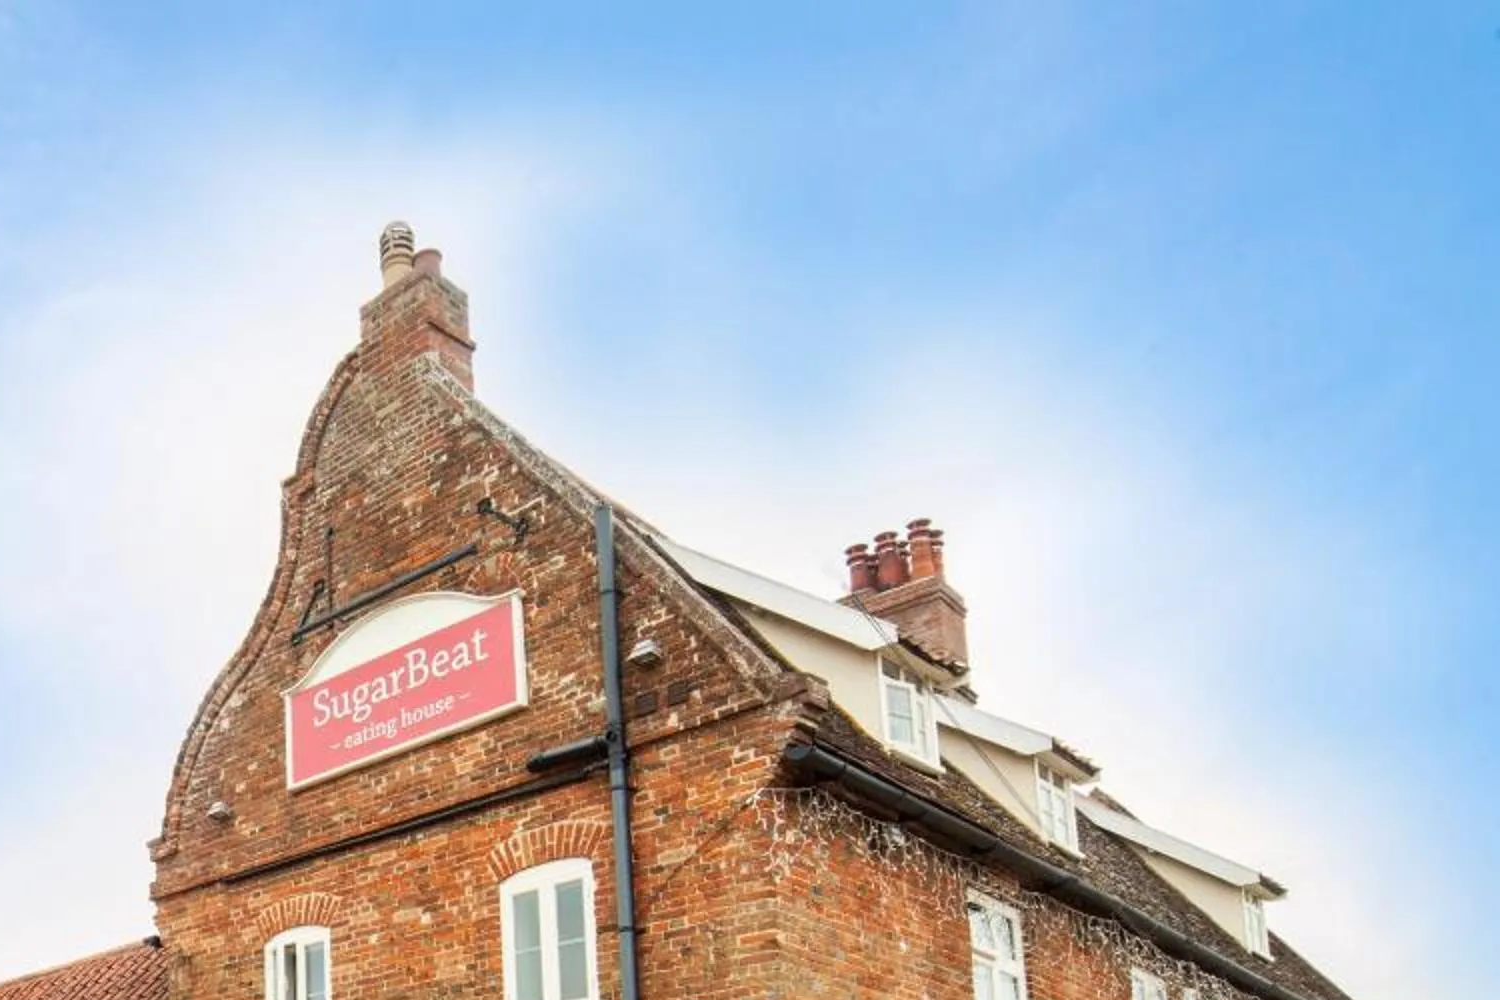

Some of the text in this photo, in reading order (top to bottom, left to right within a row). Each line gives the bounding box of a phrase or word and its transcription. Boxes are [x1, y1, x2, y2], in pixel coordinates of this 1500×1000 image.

[312, 628, 489, 727] SugarBeat
[343, 693, 454, 749] eating house
